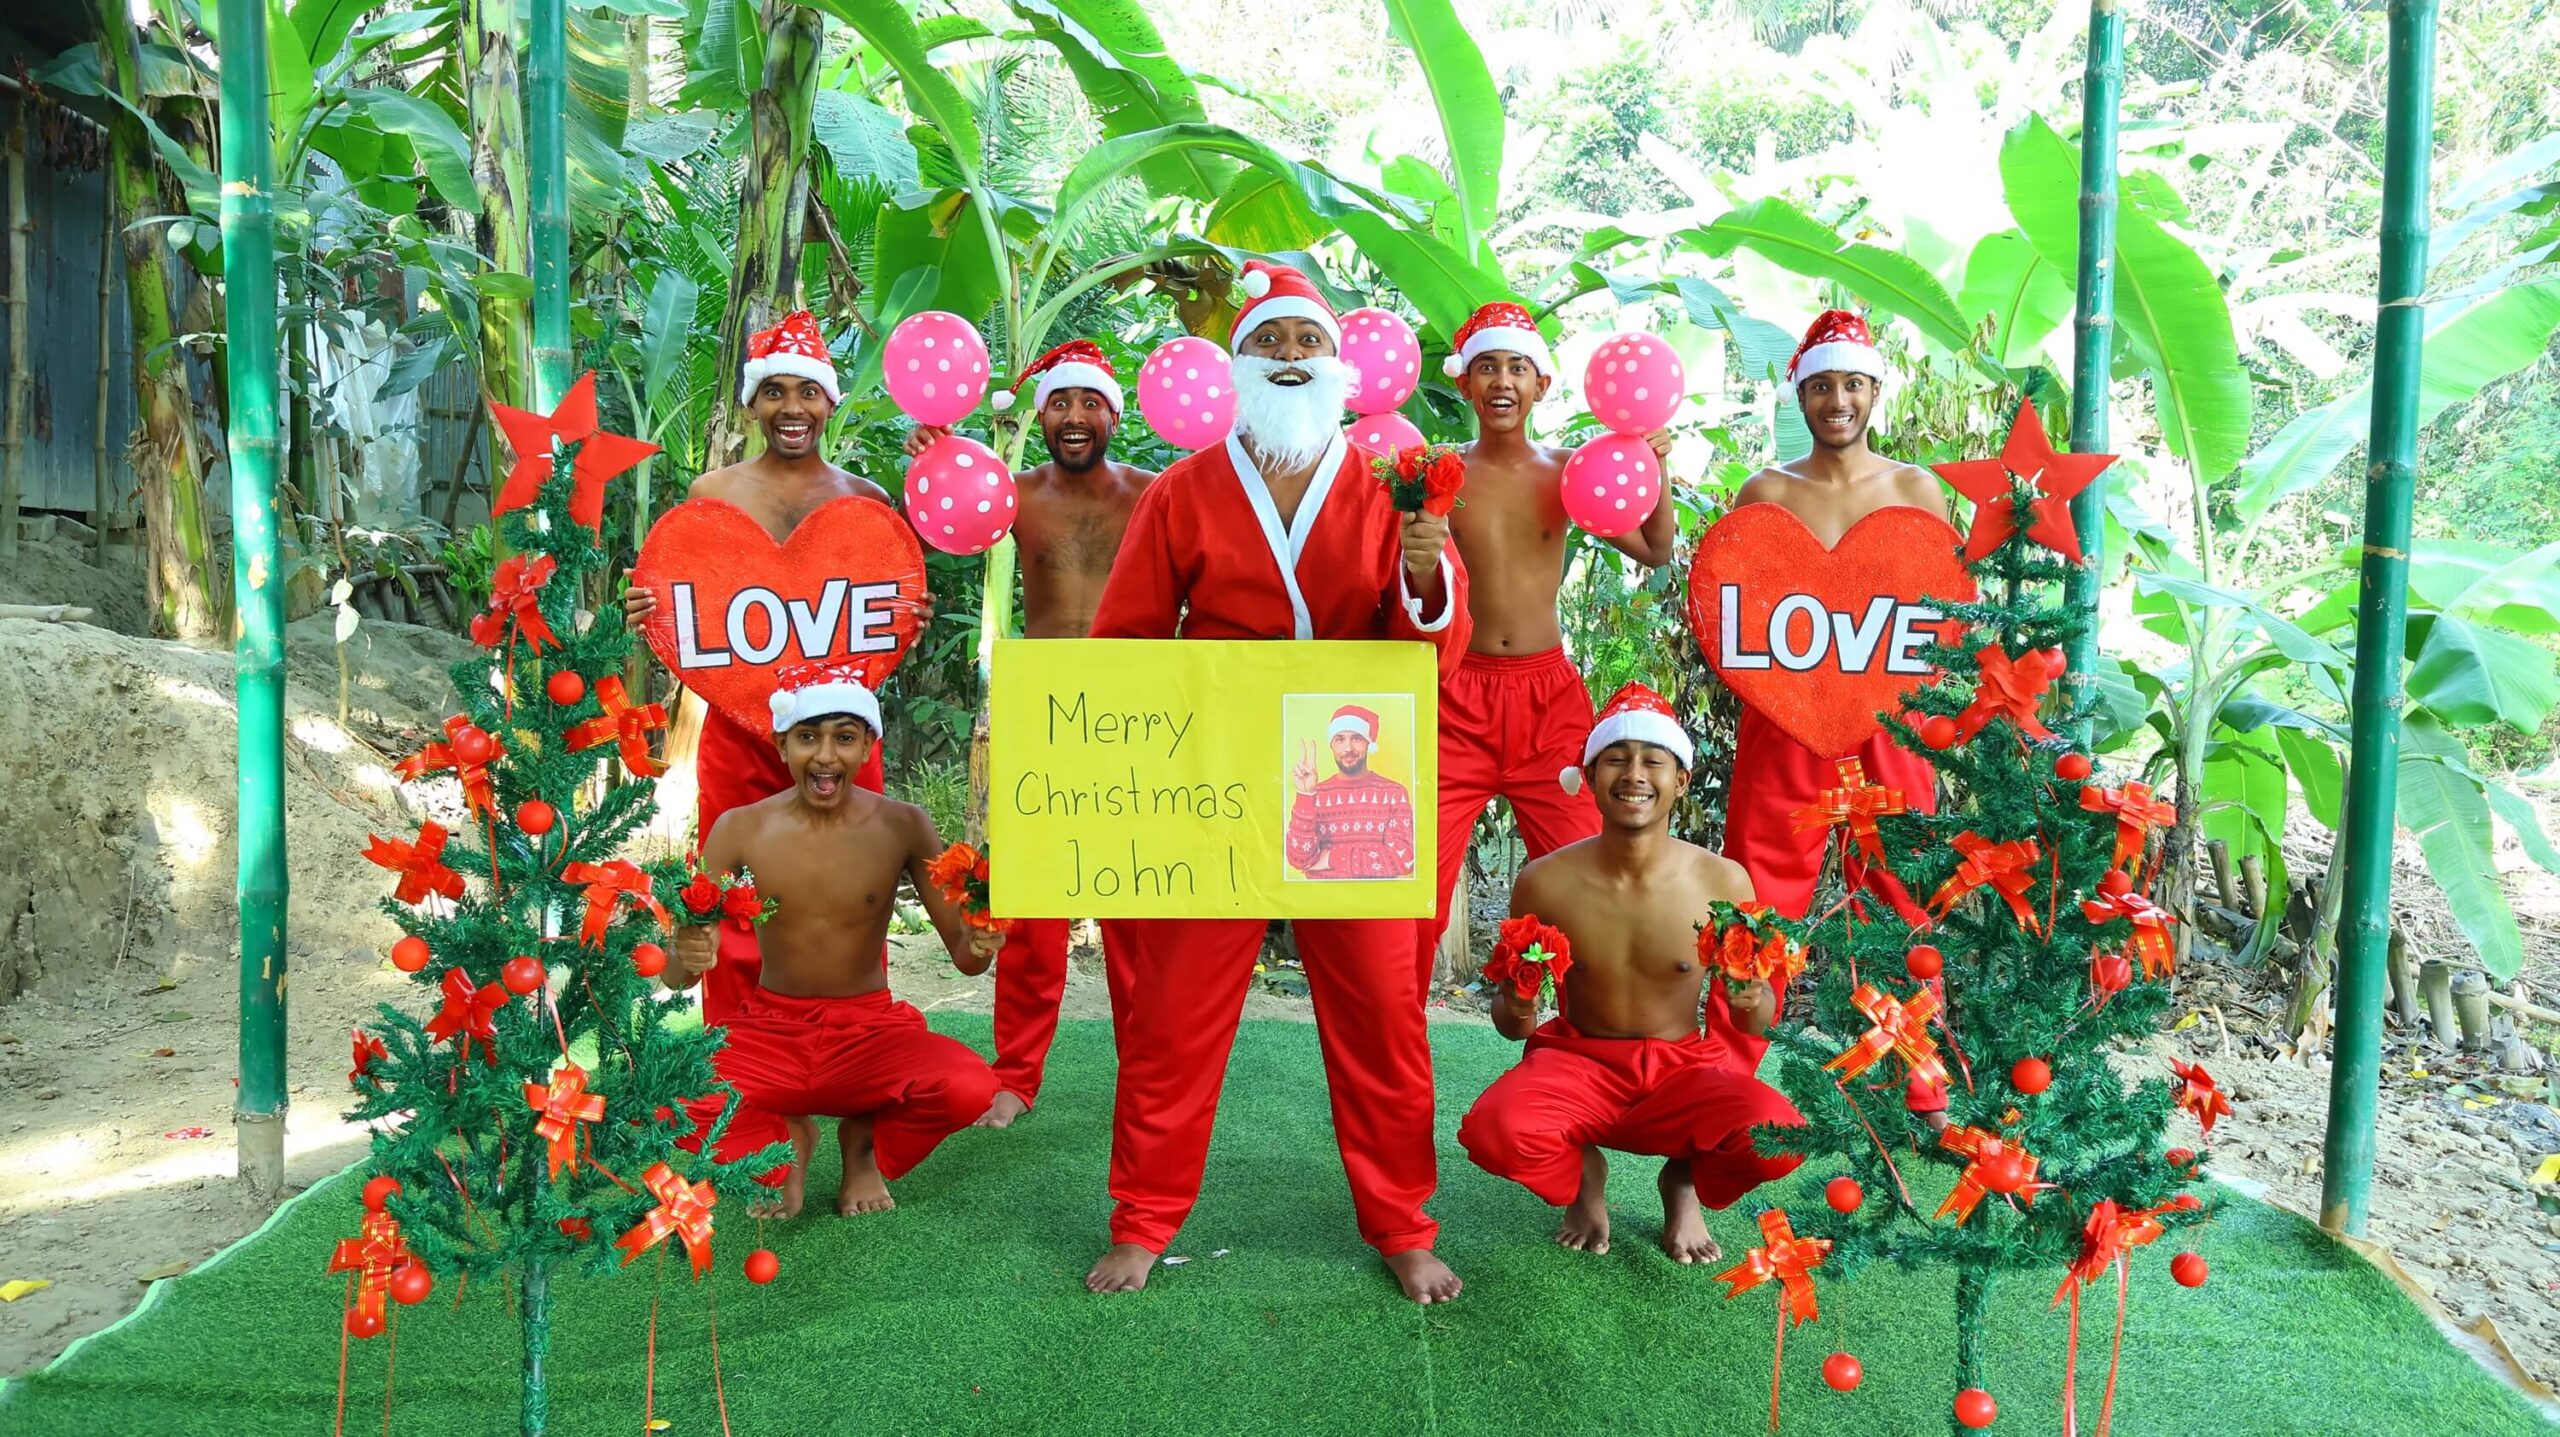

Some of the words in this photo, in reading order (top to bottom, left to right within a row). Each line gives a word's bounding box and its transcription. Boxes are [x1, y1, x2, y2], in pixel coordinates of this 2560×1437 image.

[672, 578, 899, 670] LOVE
[1719, 584, 1946, 676] LOVE
[1048, 692, 1194, 759] Merry
[1015, 766, 1247, 819] Christmas
[1066, 839, 1195, 897] John
